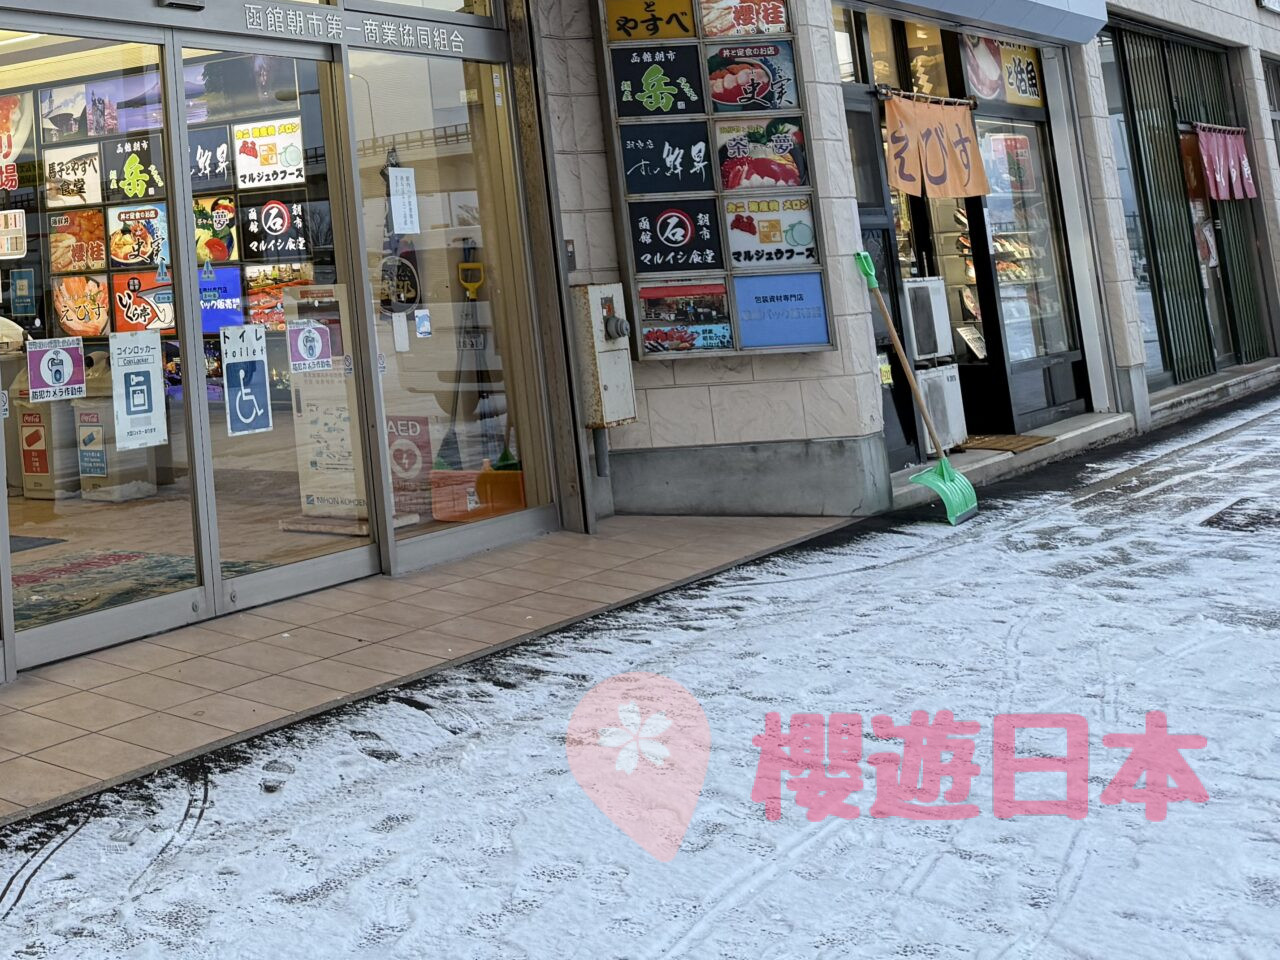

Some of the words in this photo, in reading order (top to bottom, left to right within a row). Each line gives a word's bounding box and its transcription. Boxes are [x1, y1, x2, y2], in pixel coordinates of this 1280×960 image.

[644, 1, 656, 13] と
[244, 4, 465, 54] 函館朝市第一商業協同組合
[616, 12, 690, 37] やすべ
[631, 51, 676, 63] 函館朝市
[722, 46, 775, 58] 丼と定食のお店
[236, 130, 250, 140] カニ
[278, 123, 300, 134] メロン
[116, 140, 148, 153] 函館朝市
[728, 134, 793, 158] 茶夢
[890, 120, 972, 188] えびす
[48, 158, 98, 179] 馬子とやすべ
[240, 167, 303, 184] マルジュウフーズ
[60, 178, 86, 196] 食堂
[727, 202, 746, 213] カニ
[783, 198, 809, 211] メロン
[248, 208, 258, 233] 函館
[265, 208, 283, 231] 石
[291, 204, 302, 228] 朝市
[638, 217, 652, 245] 函館
[663, 217, 686, 242] 石
[696, 213, 710, 240] 朝市
[249, 237, 306, 252] マルイシ食堂
[640, 249, 716, 265] マルイシ食堂
[732, 247, 815, 263] マルジュウフーズ
[755, 294, 805, 304] 包装資材専門店
[60, 303, 106, 322] えびす
[116, 292, 151, 324] いくら亭
[222, 329, 263, 345] トイレ
[117, 345, 157, 355] コインロッカー
[224, 347, 265, 359] toilet
[292, 360, 332, 372] 防犯カメラ作動中
[31, 388, 83, 400] 防犯カメラ作動中
[387, 421, 420, 436] AED
